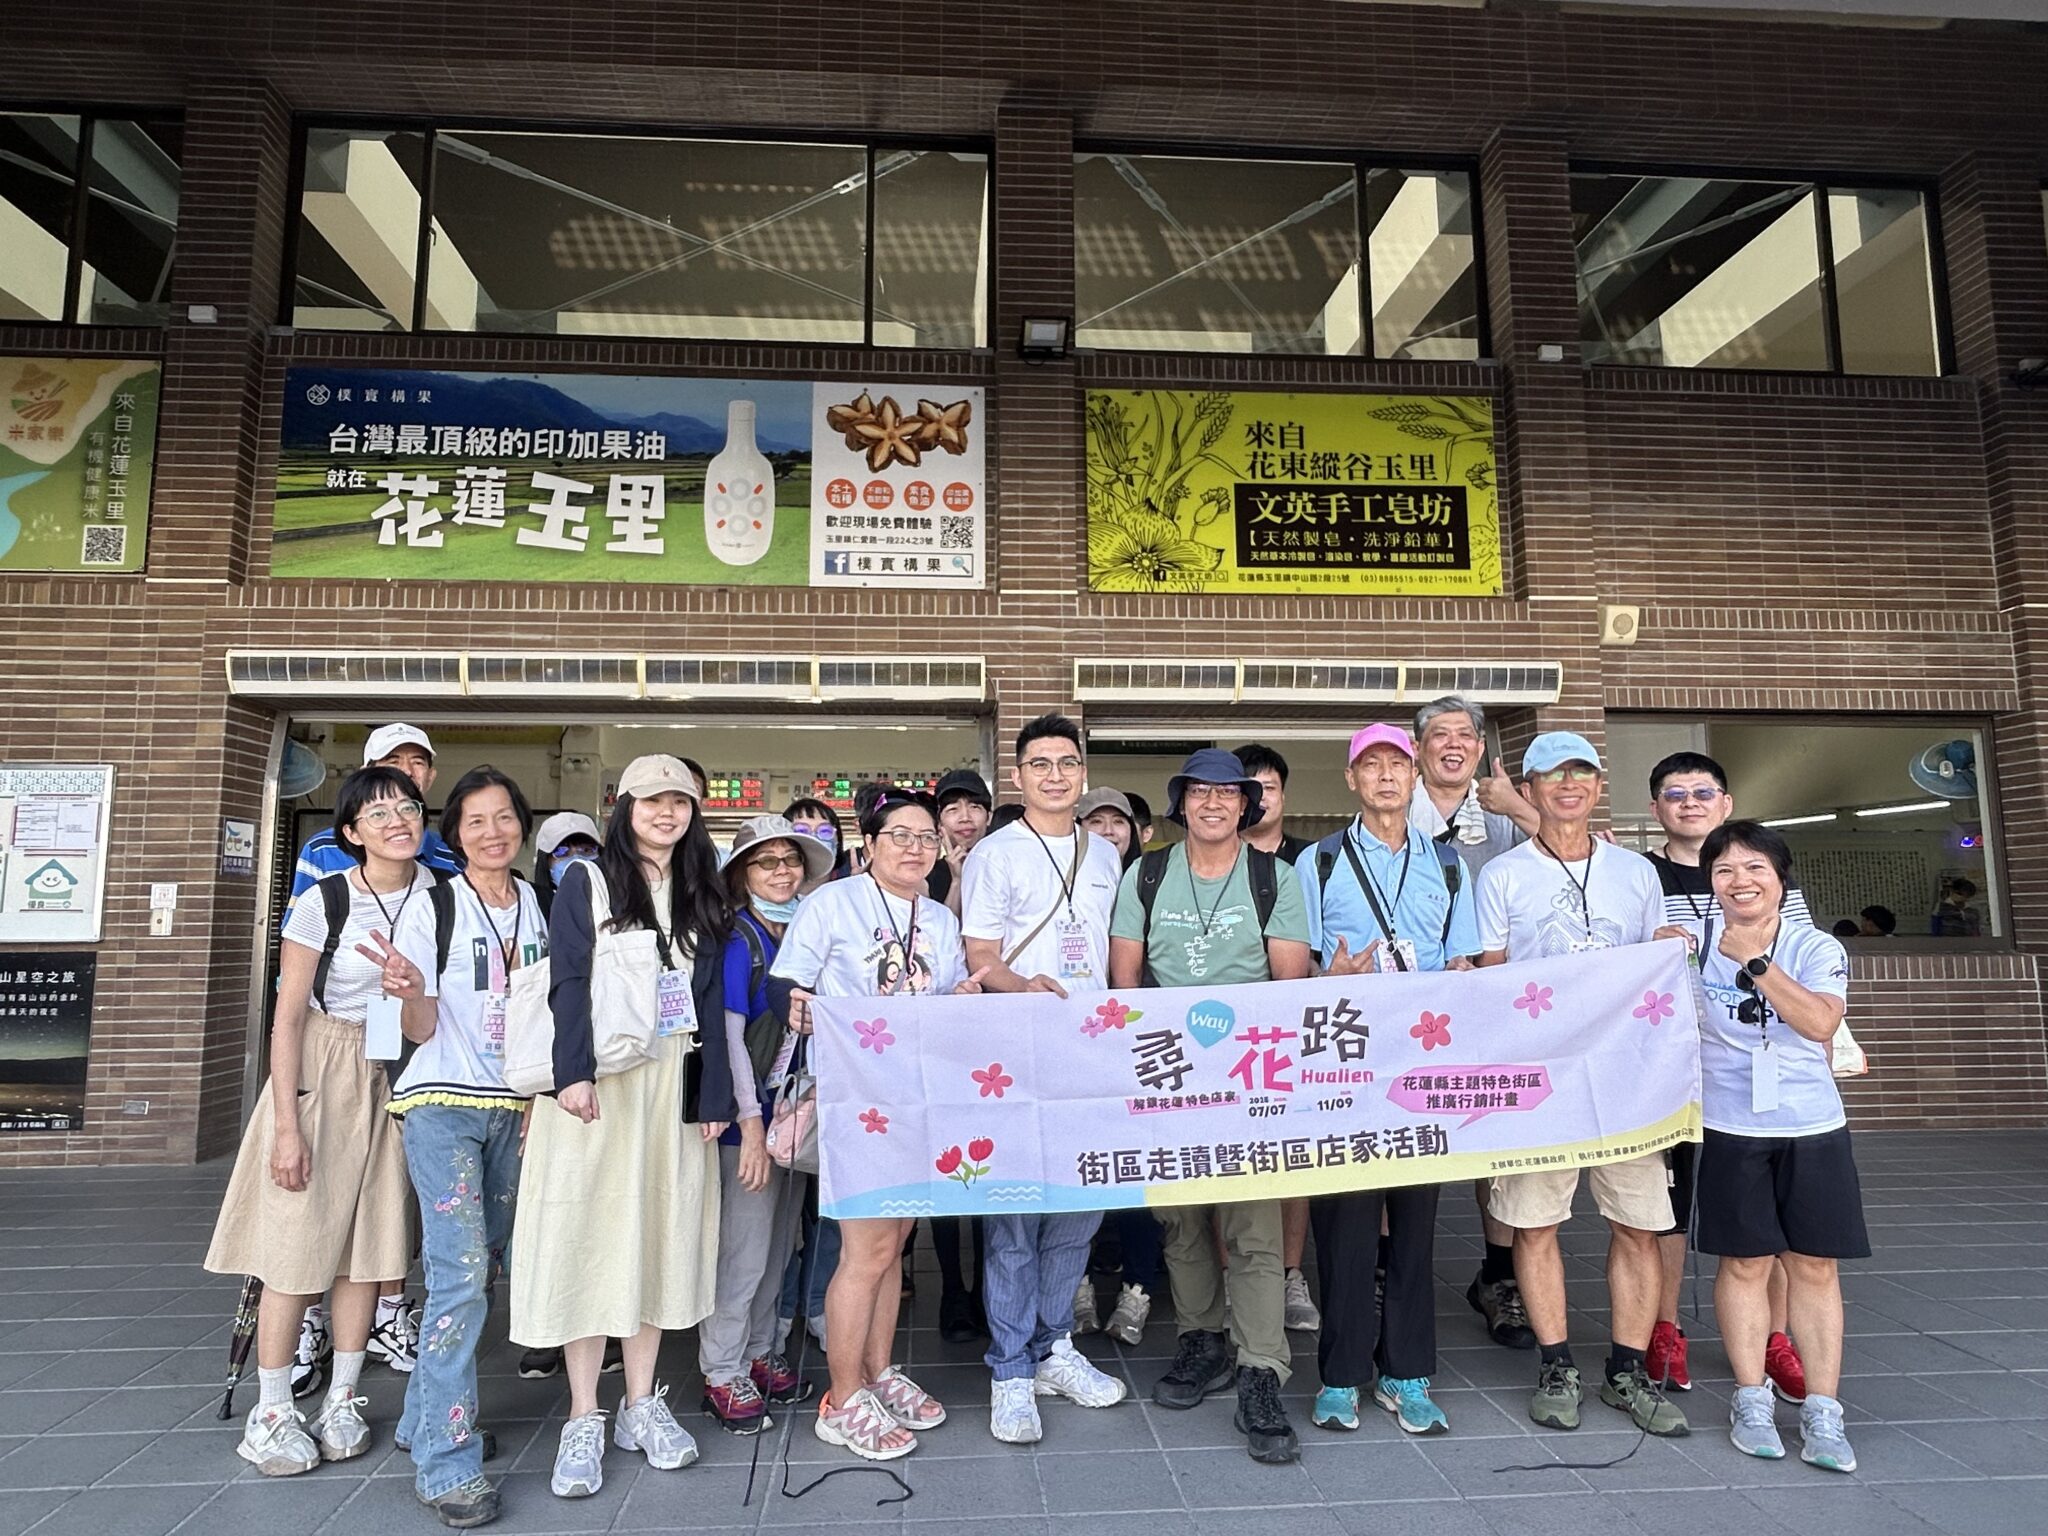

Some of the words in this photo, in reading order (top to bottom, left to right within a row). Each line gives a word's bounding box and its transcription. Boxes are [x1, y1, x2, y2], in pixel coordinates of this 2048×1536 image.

[328, 423, 666, 461] 台灣最頂級的印加果油
[1244, 420, 1305, 450] 來自
[105, 392, 135, 520] 來自花蓮玉里
[1245, 450, 1439, 481] 花東縱谷玉里
[82, 431, 105, 519] 有機健康米
[326, 469, 367, 489] 就在
[370, 465, 666, 555] 花蓮玉里
[1248, 490, 1454, 526] 文英手工皂坊
[825, 515, 933, 530] 歡迎現場免費體驗
[825, 535, 934, 545] 玉里鎮仁愛路一段224之3號
[0, 970, 76, 983] 山星空之旅
[1190, 1011, 1230, 1033] Way
[1301, 1069, 1374, 1085] Hualien
[1402, 1072, 1542, 1092] 花蓮縣主題特色街區
[1132, 1091, 1237, 1111] 解鎖花蓮特色店家
[1248, 1104, 1287, 1118] 07/07
[1316, 1097, 1354, 1112] 11/09
[1425, 1092, 1519, 1110] 推廣行銷計畫
[1076, 1123, 1450, 1187] 街區走讀暨街區店家活動
